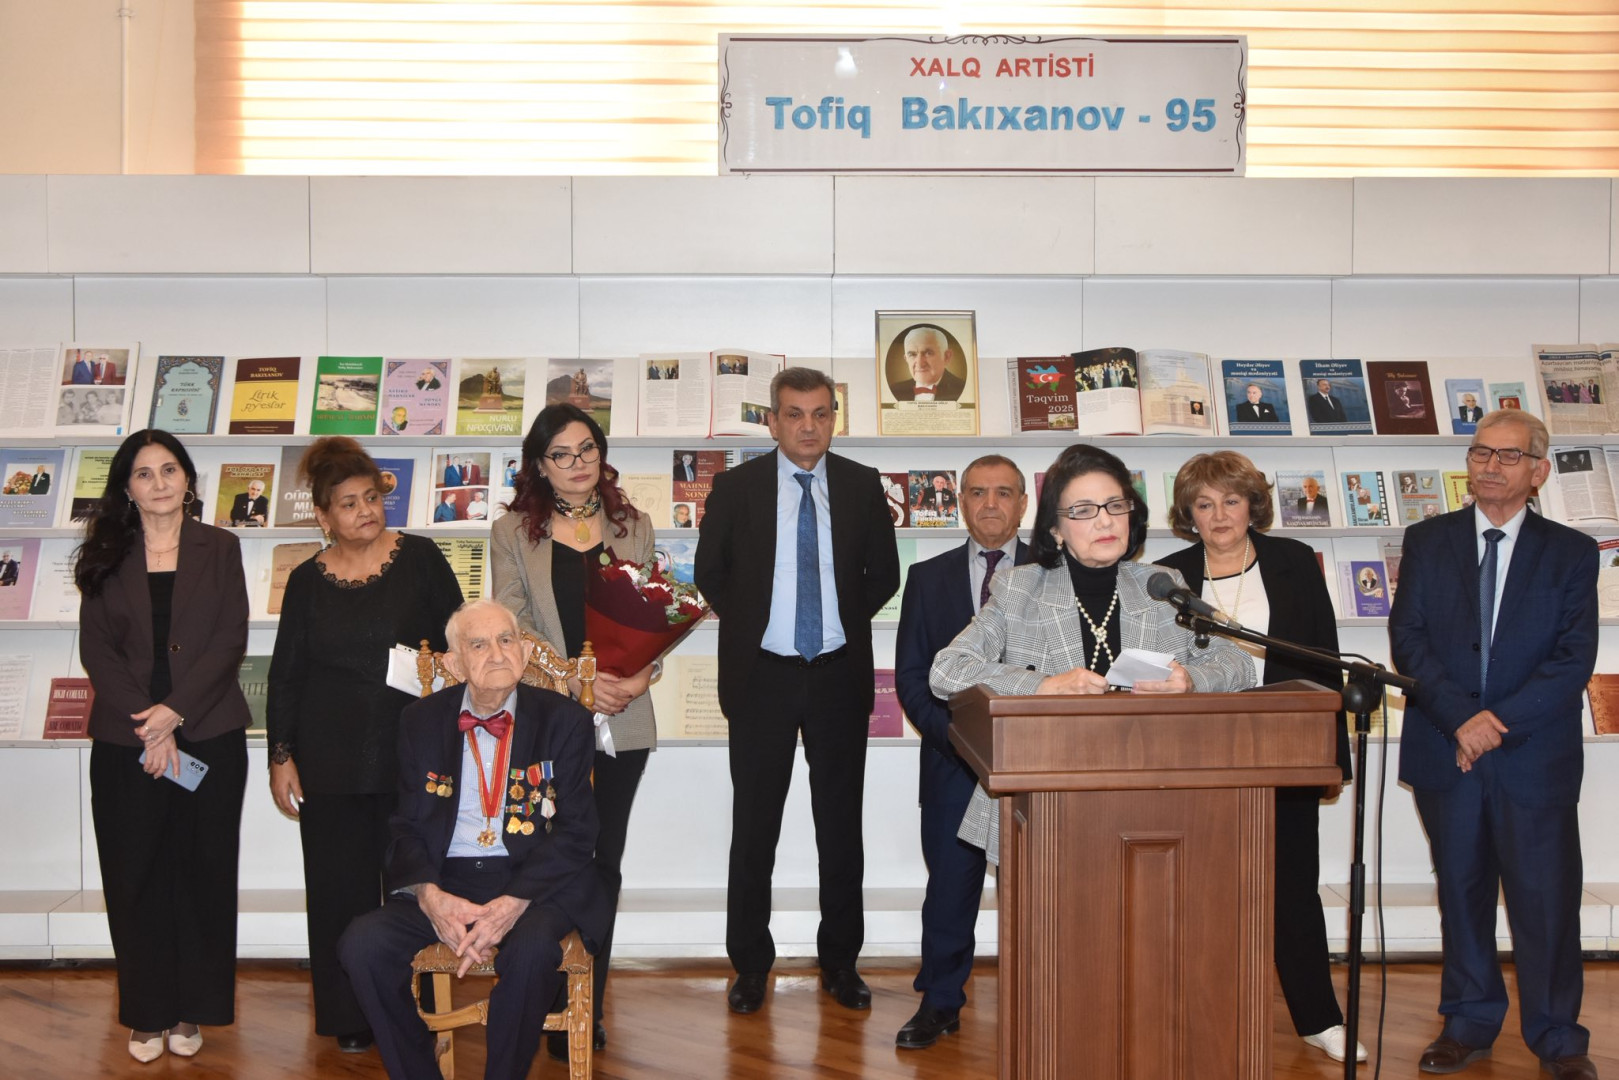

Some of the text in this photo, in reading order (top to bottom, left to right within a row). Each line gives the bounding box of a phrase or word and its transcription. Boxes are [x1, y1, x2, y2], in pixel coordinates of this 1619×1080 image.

[910, 53, 1095, 78] XALQ ARTİSTİ
[766, 97, 871, 137] Tofiq
[902, 97, 1125, 131] Bakıxanov
[1166, 98, 1217, 132] 95
[249, 389, 279, 402] Lirik
[1026, 393, 1069, 405] Təqvim
[1048, 404, 1074, 414] 2025
[489, 415, 517, 423] NURLU
[466, 424, 513, 433] NAXÇIVAN
[293, 510, 316, 521] DÜN
